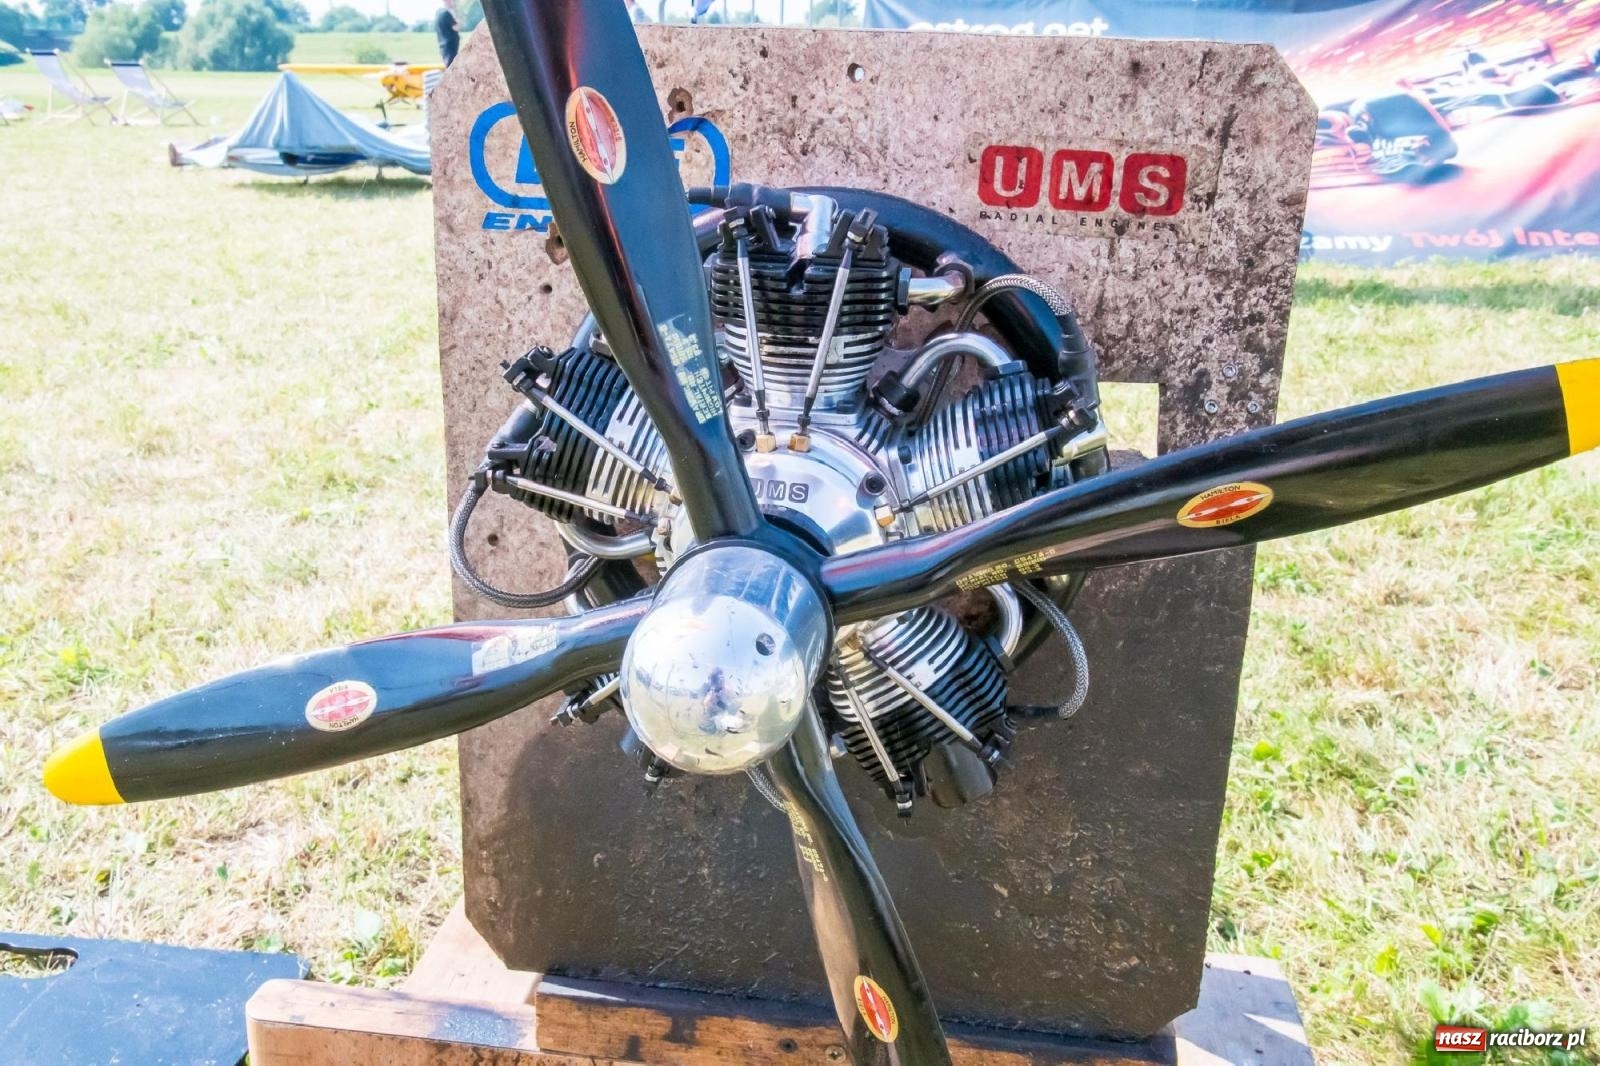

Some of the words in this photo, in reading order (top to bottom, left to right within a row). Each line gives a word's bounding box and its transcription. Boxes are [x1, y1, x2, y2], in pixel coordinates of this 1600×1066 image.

[569, 121, 587, 163] HAMILTON
[993, 155, 1171, 208] UMS
[979, 210, 1058, 225] RADIAL
[1079, 216, 1177, 232] ENGINES
[1200, 485, 1241, 500] HAMILTON
